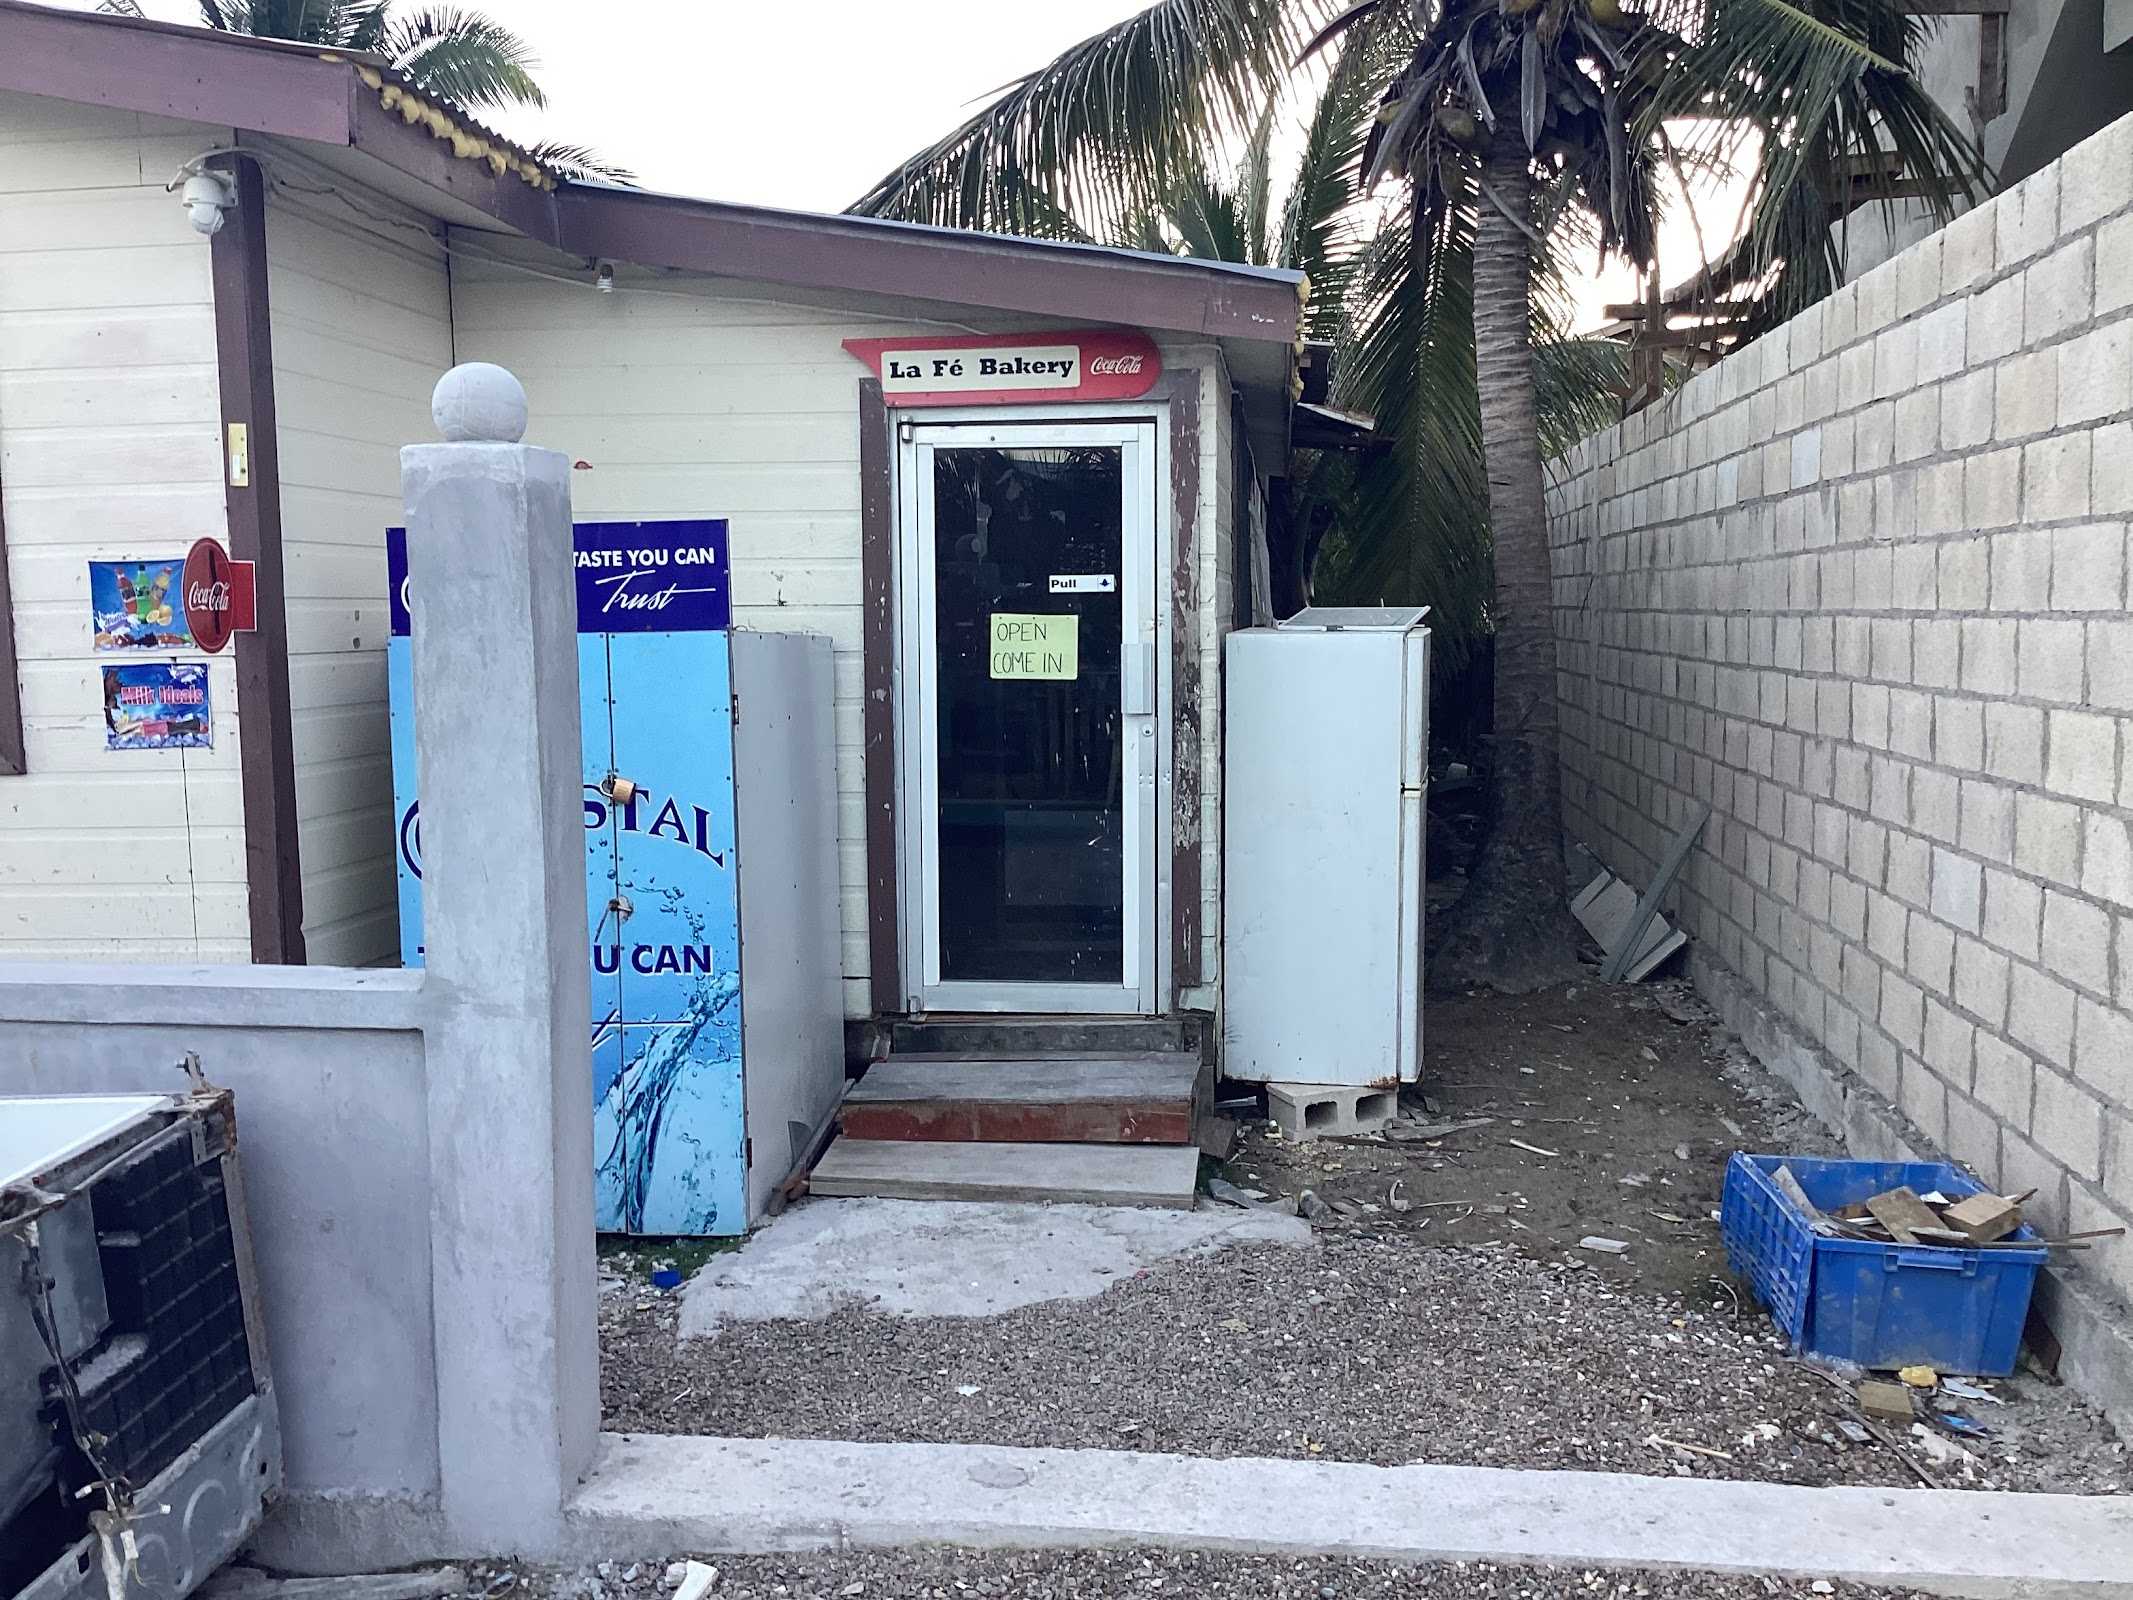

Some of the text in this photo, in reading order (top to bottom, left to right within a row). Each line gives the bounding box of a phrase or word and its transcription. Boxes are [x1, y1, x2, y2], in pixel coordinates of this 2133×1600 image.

[889, 356, 1074, 379] La Fé Bakery
[626, 549, 669, 566] YOU
[674, 547, 715, 565] CAN
[595, 569, 716, 613] Trust
[1051, 579, 1077, 588] Pull
[996, 622, 1047, 642] OPEN
[993, 652, 1063, 674] COME IN
[120, 685, 204, 706] Milk Ideals
[631, 944, 713, 976] CAN
